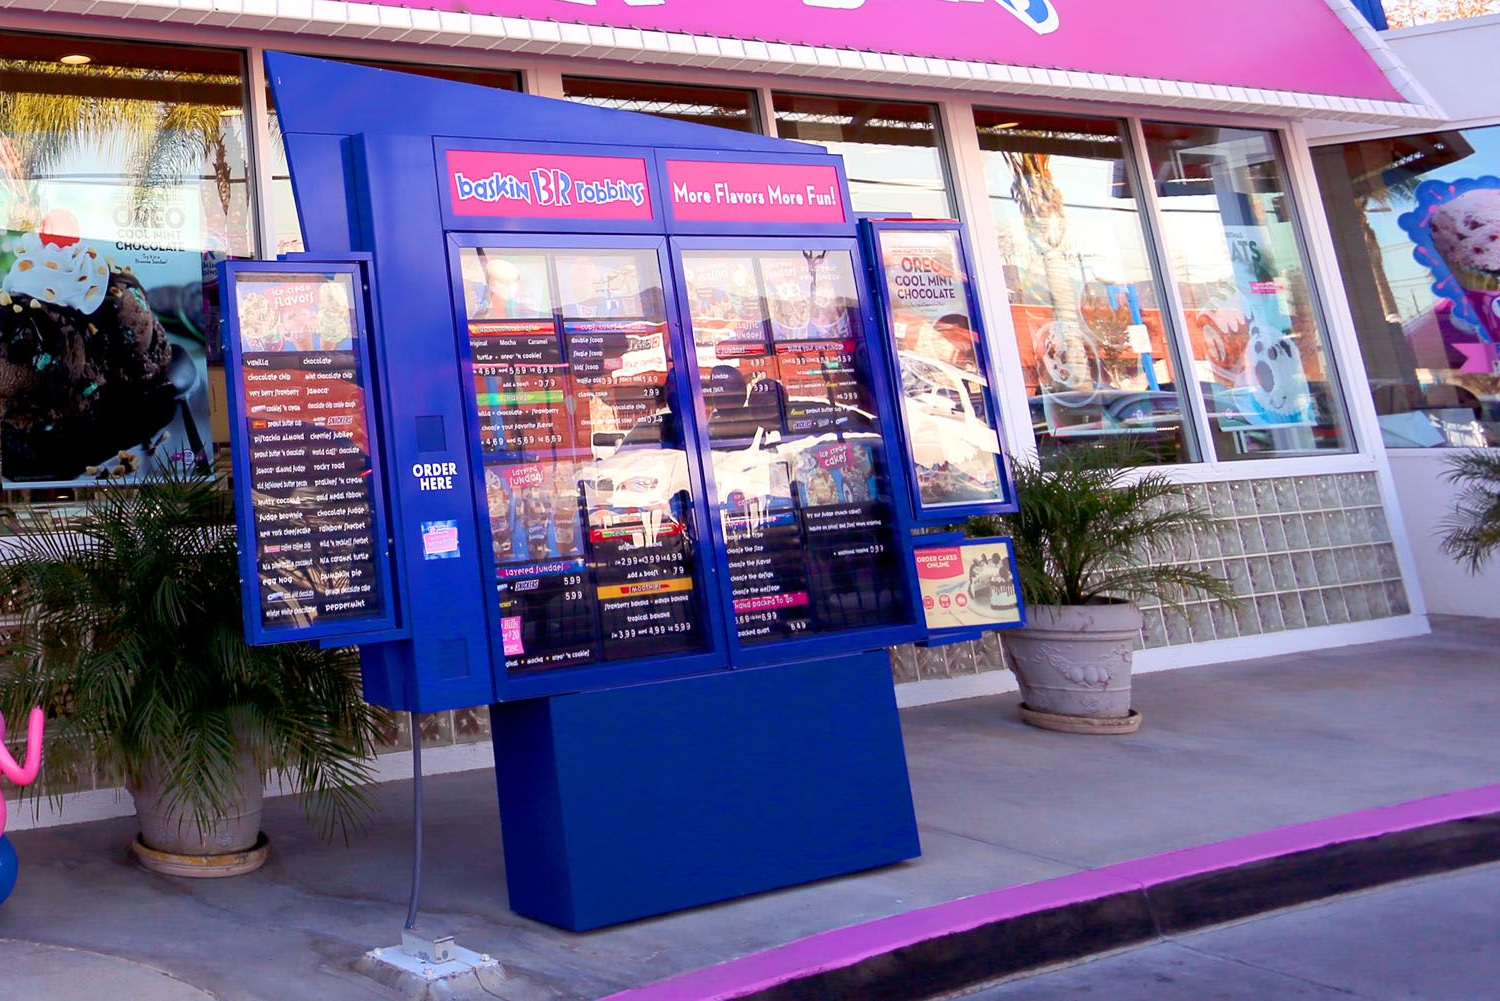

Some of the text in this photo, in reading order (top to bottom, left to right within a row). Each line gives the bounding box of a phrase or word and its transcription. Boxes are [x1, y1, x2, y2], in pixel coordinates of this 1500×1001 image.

[530, 168, 571, 206] BR
[673, 182, 837, 206] More Flavors More Fun!
[116, 241, 185, 252] CHOCOLATE
[895, 275, 952, 286] COOL MINT
[897, 288, 956, 299] CHOCOLATE
[248, 373, 277, 381] chocolate
[333, 431, 353, 439] jubilee
[824, 451, 847, 466] cakes
[314, 462, 330, 471] rocky
[412, 462, 457, 477] ORDER
[512, 466, 537, 477] layered
[420, 476, 453, 491] HERE
[259, 511, 303, 522] fudge brownie
[317, 507, 365, 517] chocolate fudge
[318, 524, 342, 532] rainbow
[916, 555, 937, 563] ORDER
[351, 569, 362, 577] pie
[505, 567, 534, 577] layered
[262, 578, 277, 586] egg
[325, 600, 365, 612] peppermint
[752, 599, 776, 608] packed
[785, 596, 794, 604] go
